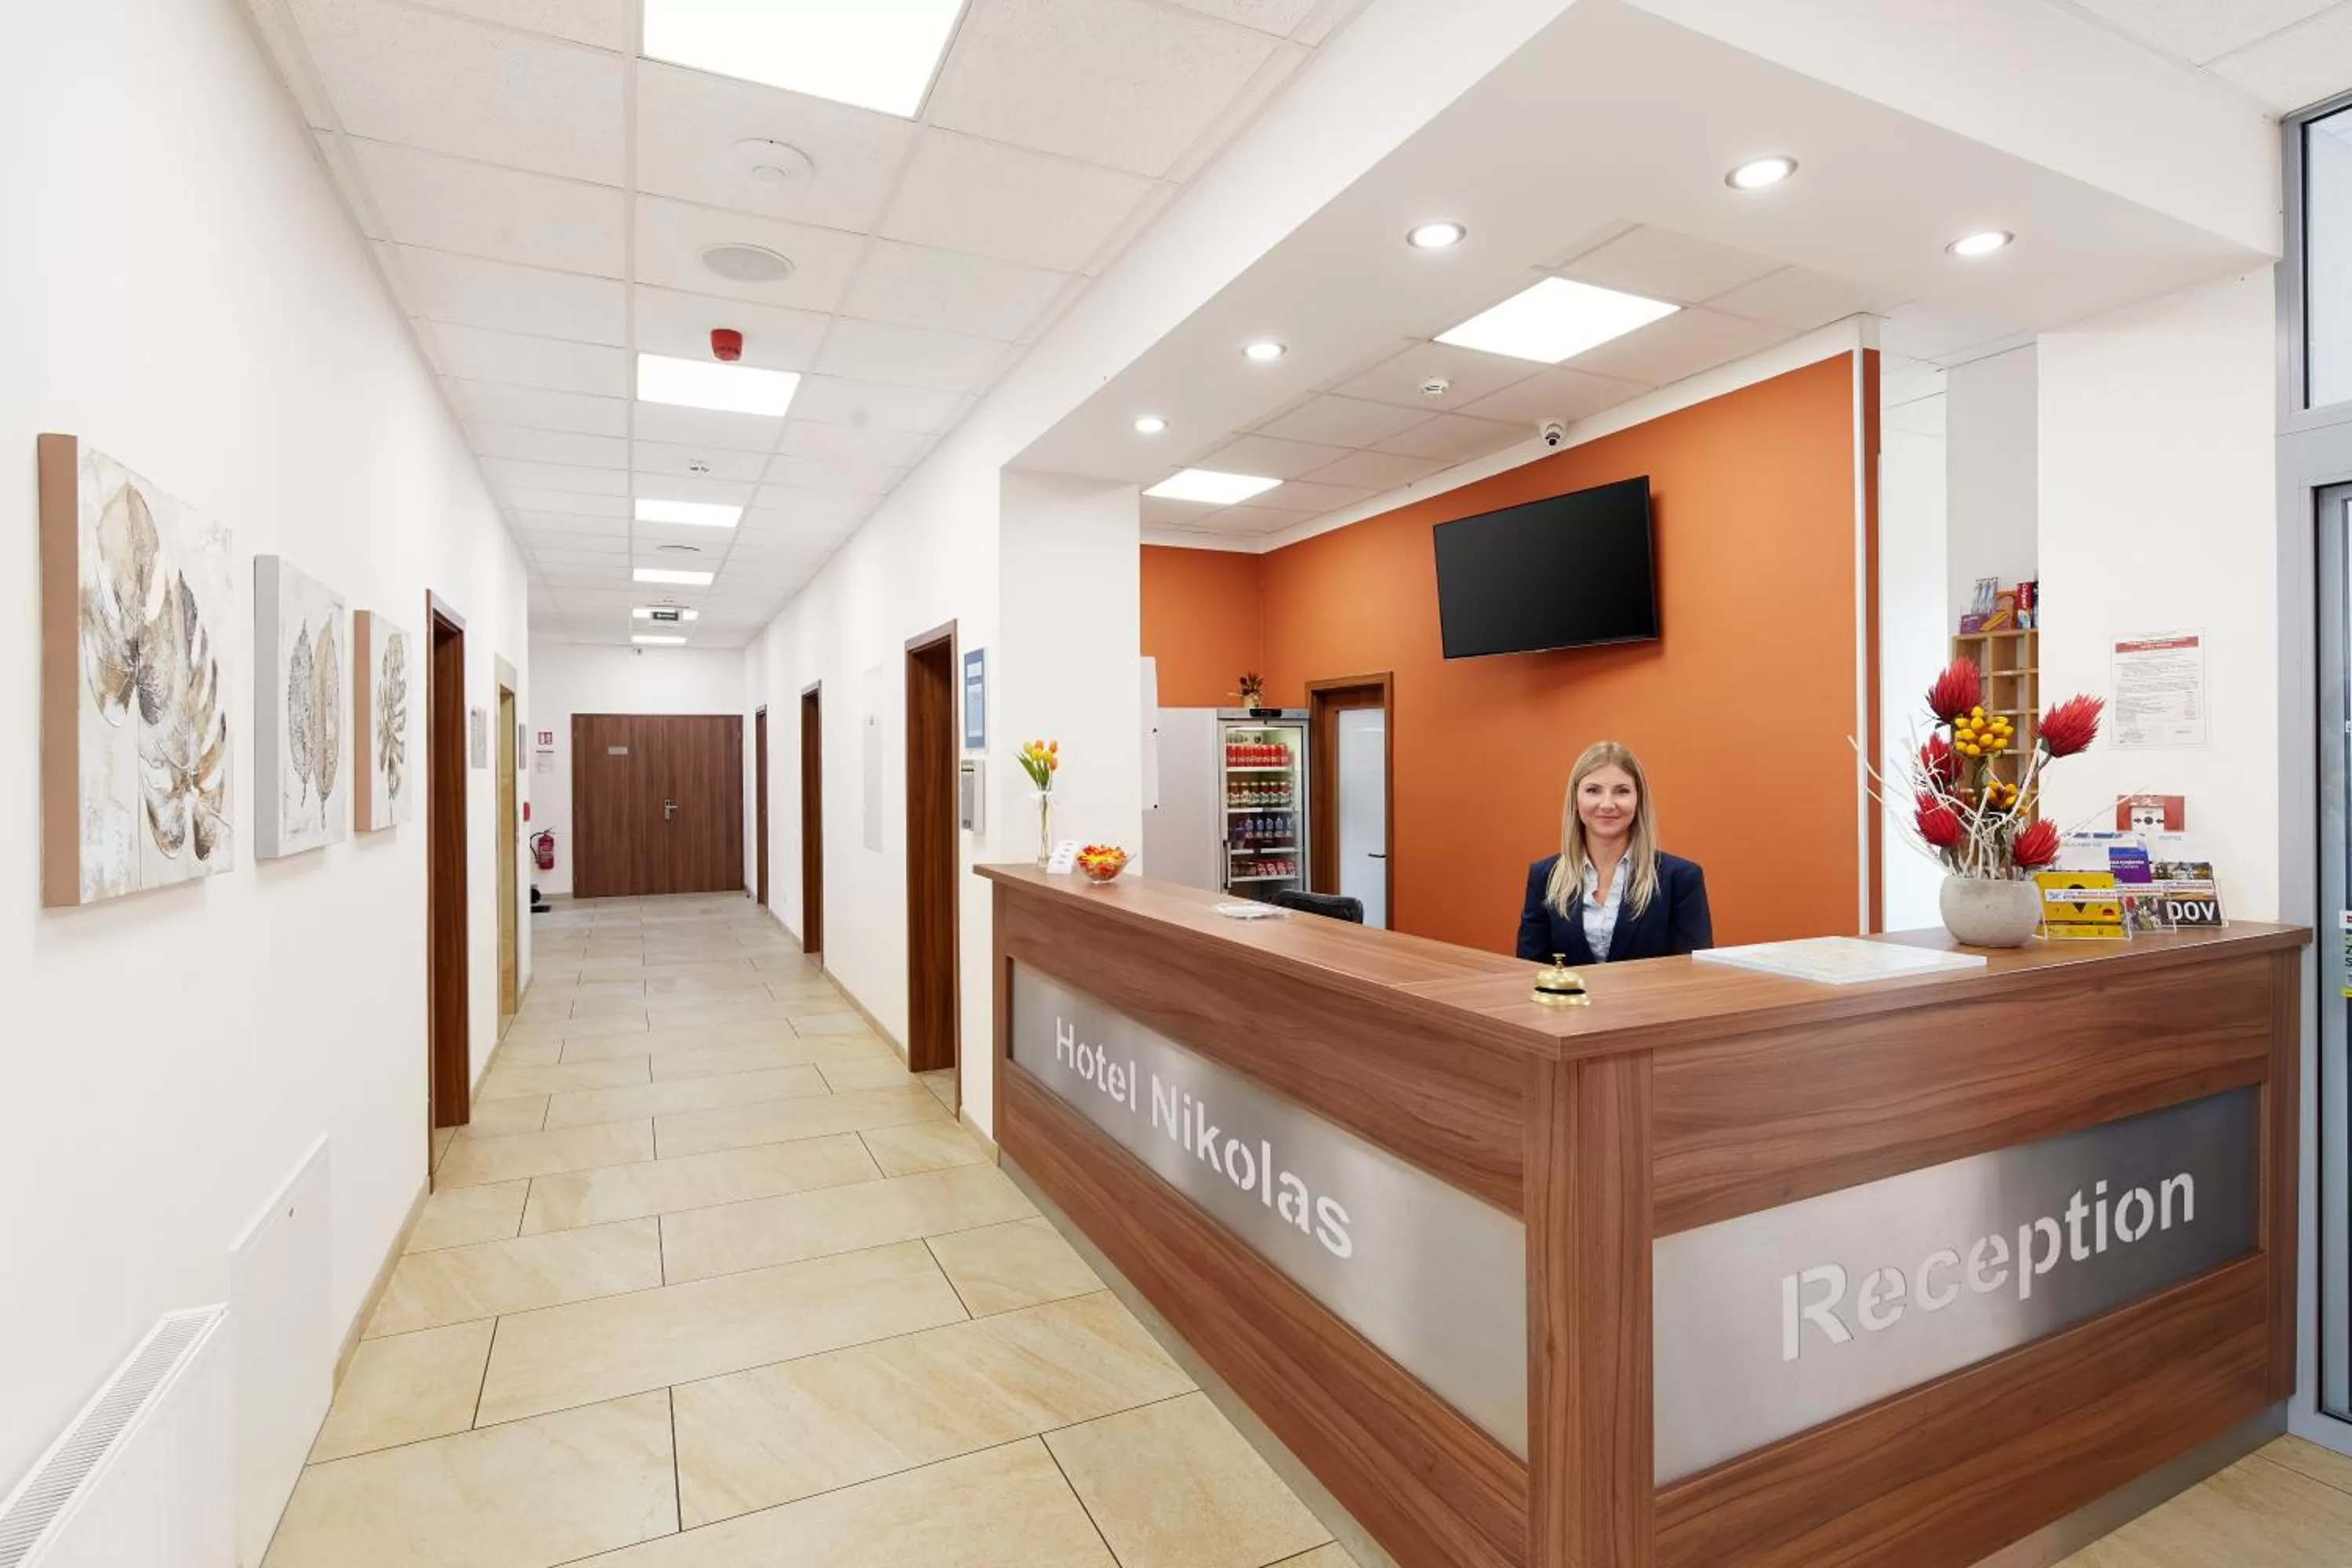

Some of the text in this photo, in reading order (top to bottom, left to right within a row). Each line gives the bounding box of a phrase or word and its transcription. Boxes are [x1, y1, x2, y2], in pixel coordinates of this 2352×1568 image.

[2165, 902, 2214, 921] DOV
[1055, 1015, 1352, 1259] Hotel Nikolas
[1782, 1173, 2194, 1361] Reception
